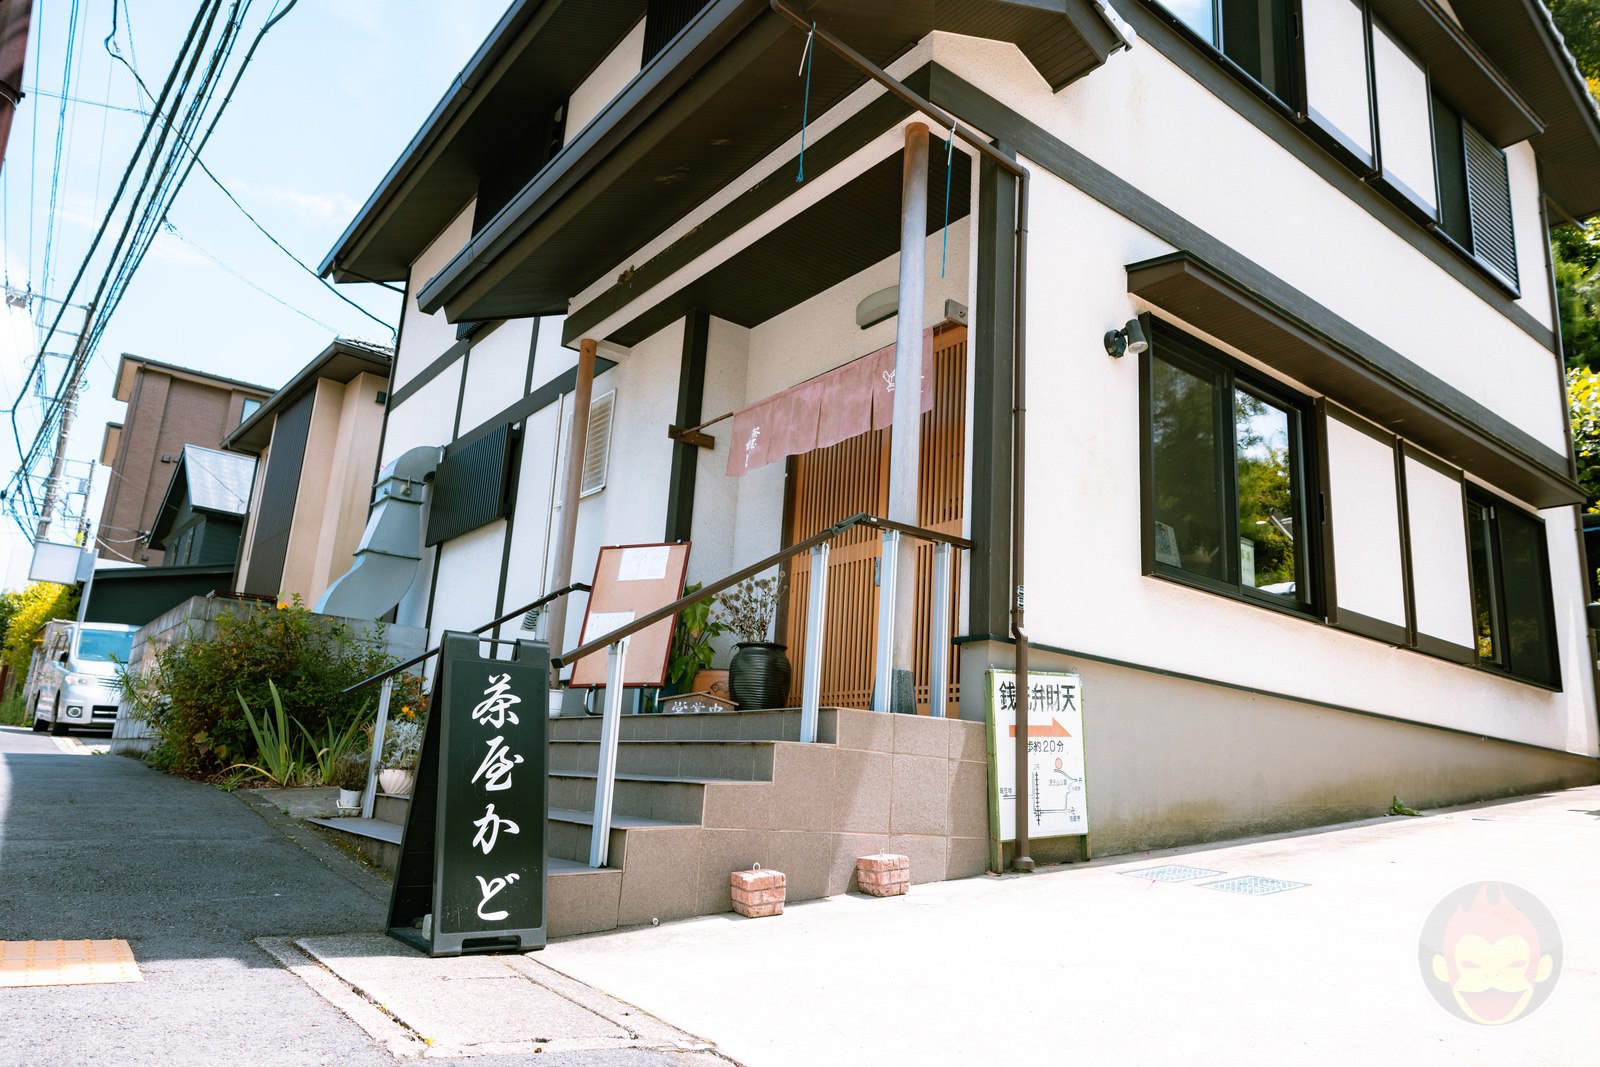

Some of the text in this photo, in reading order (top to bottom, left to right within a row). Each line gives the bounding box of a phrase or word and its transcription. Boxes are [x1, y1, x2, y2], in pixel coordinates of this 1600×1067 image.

[999, 681, 1076, 712] 銭弁財天
[471, 672, 524, 921] 茶屋かど
